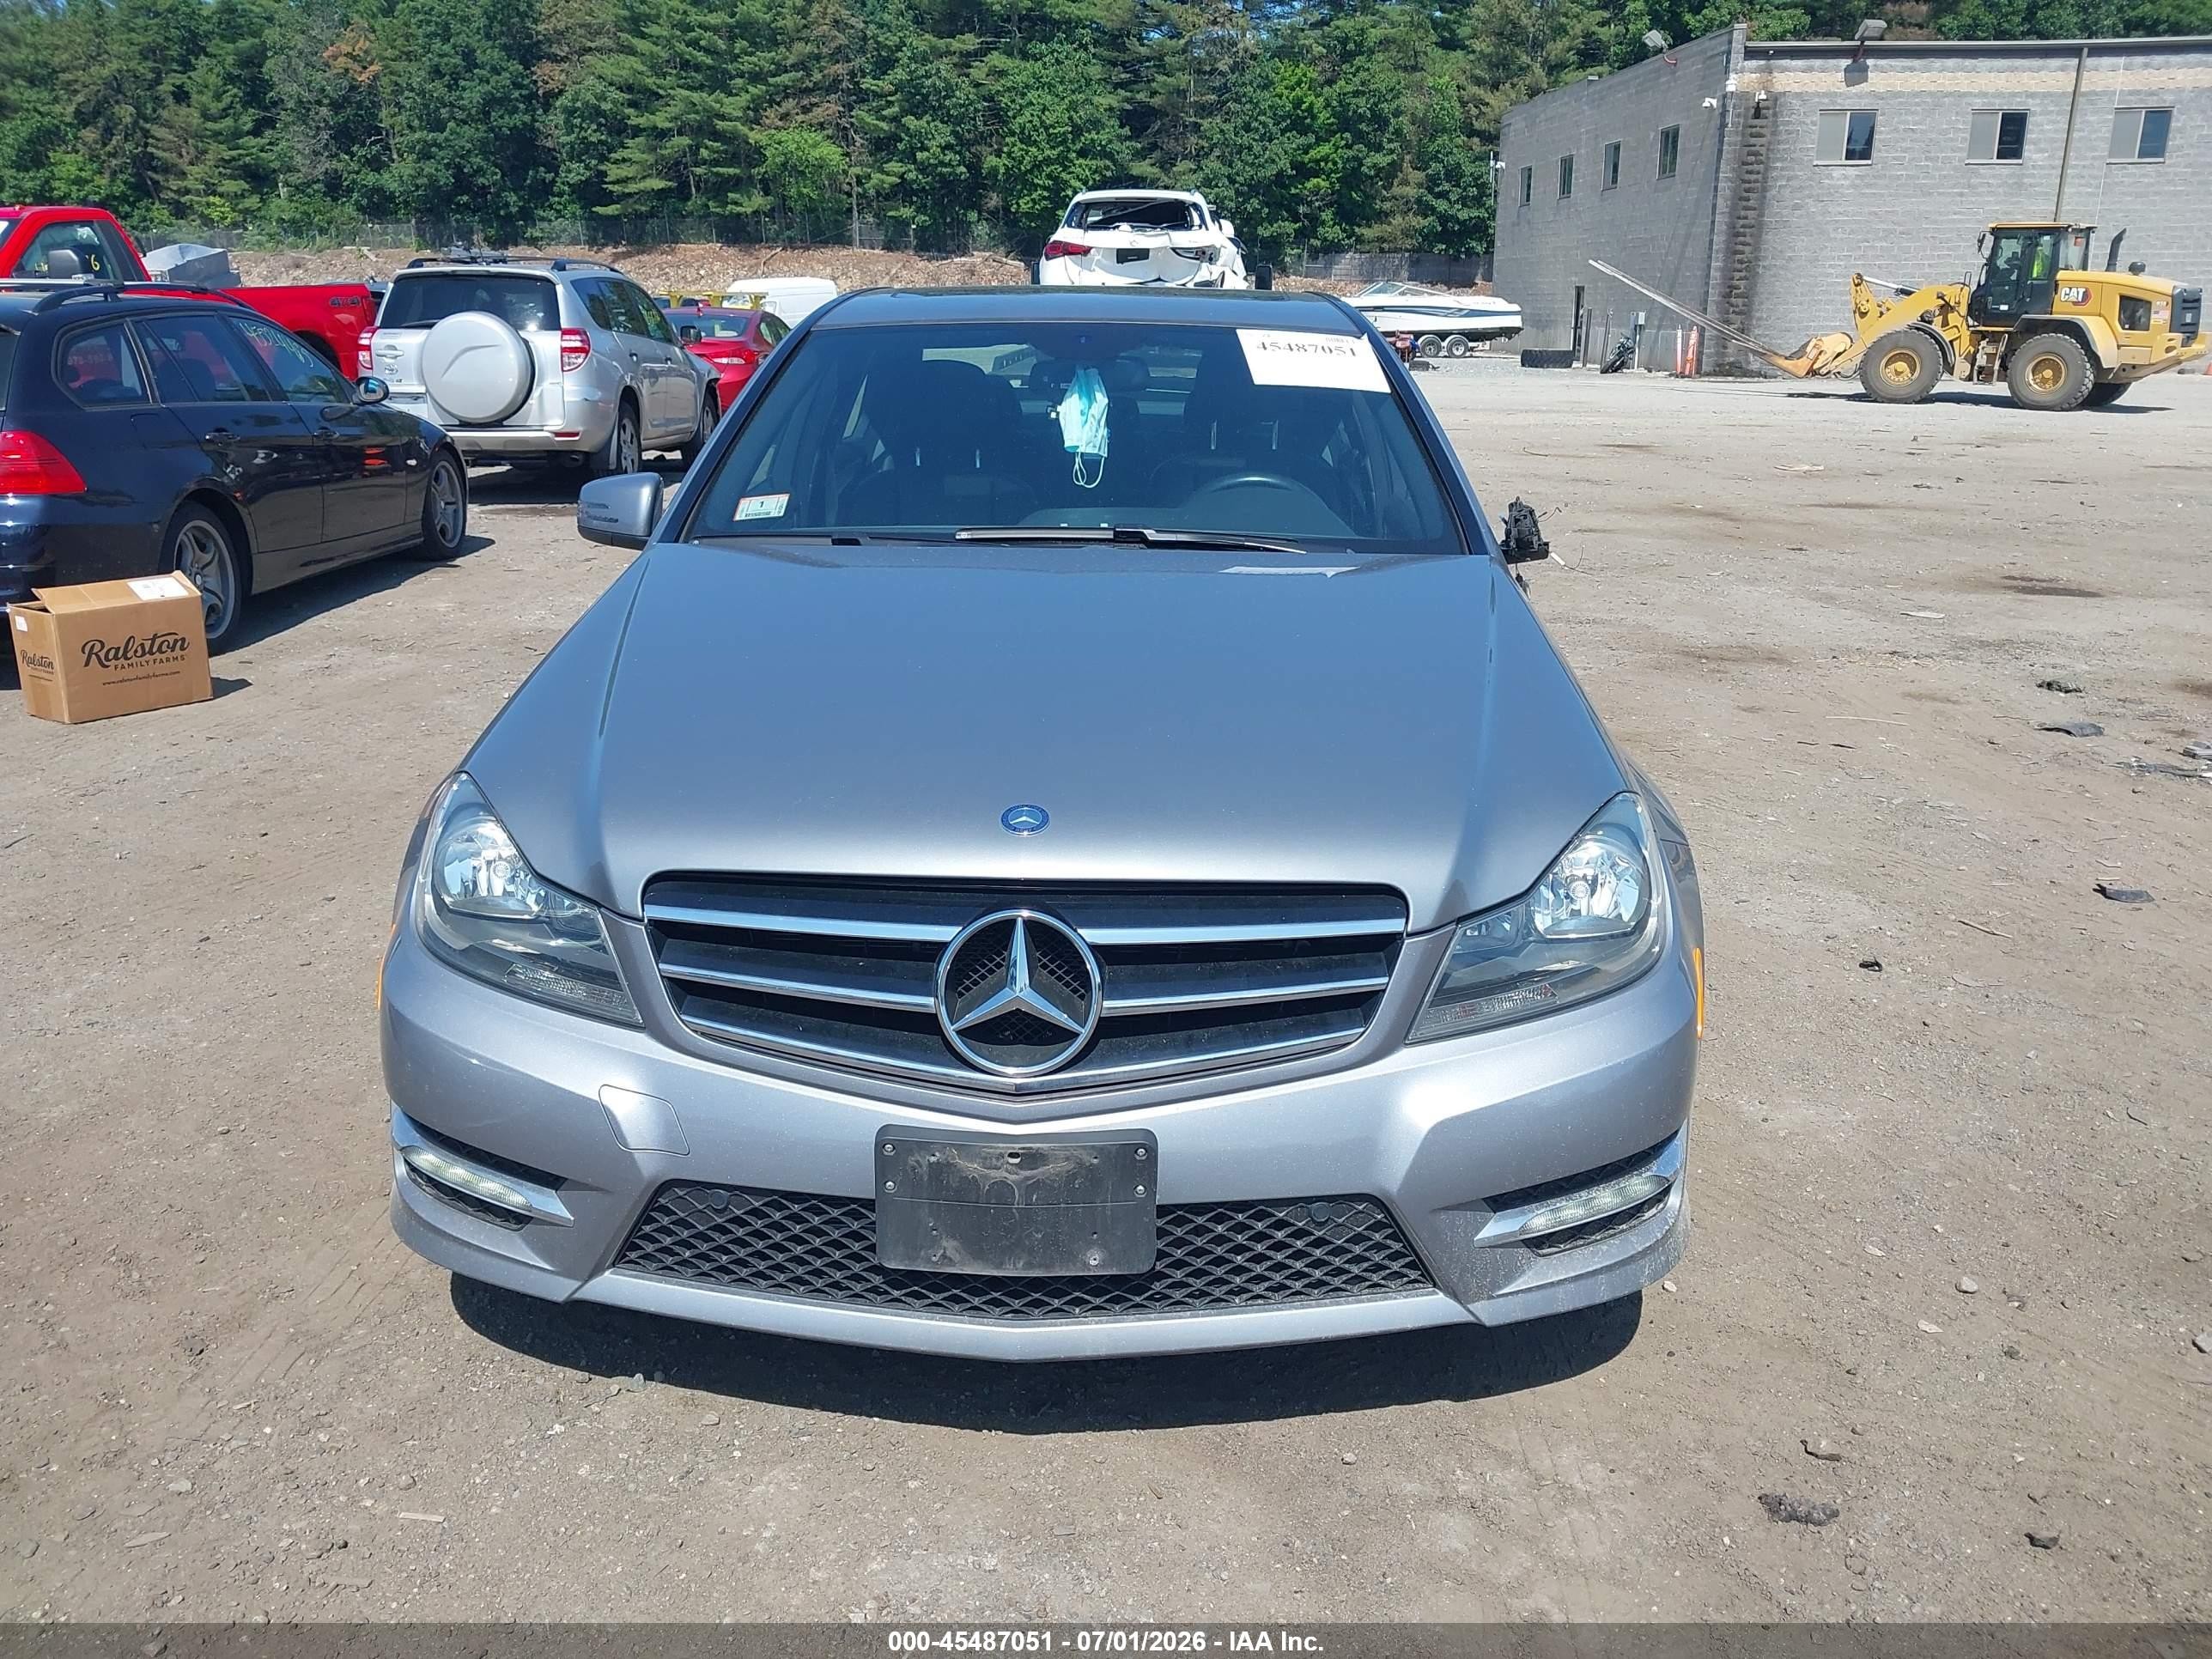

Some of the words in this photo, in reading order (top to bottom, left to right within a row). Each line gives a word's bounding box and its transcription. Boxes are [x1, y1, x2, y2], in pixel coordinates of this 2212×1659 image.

[2060, 287, 2087, 302] CAT
[1257, 341, 1356, 357] 45487051
[82, 632, 190, 668] Ralston
[21, 649, 54, 670] Ralston
[114, 659, 151, 672] FAMILY
[153, 654, 186, 665] FARMS
